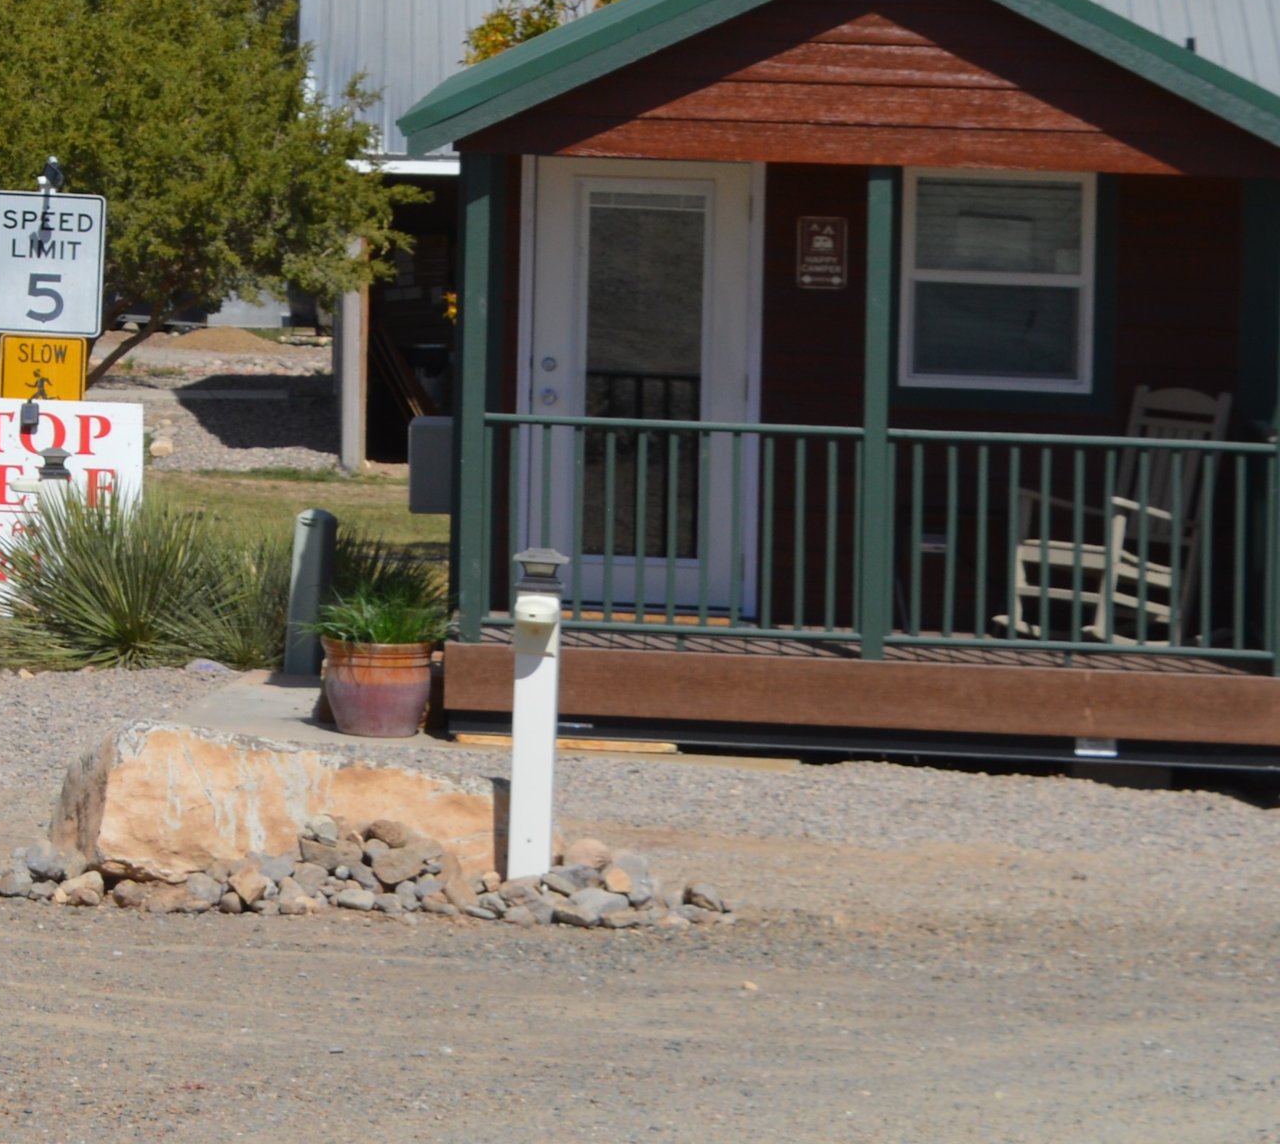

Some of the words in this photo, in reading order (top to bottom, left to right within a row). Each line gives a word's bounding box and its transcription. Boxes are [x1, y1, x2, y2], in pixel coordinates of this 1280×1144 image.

[3, 209, 93, 233] SPEED
[11, 238, 82, 261] LIMIT
[804, 256, 838, 264] HAPPY
[801, 265, 842, 274] CAMPER
[26, 273, 64, 323] 5
[18, 343, 68, 364] SLOW
